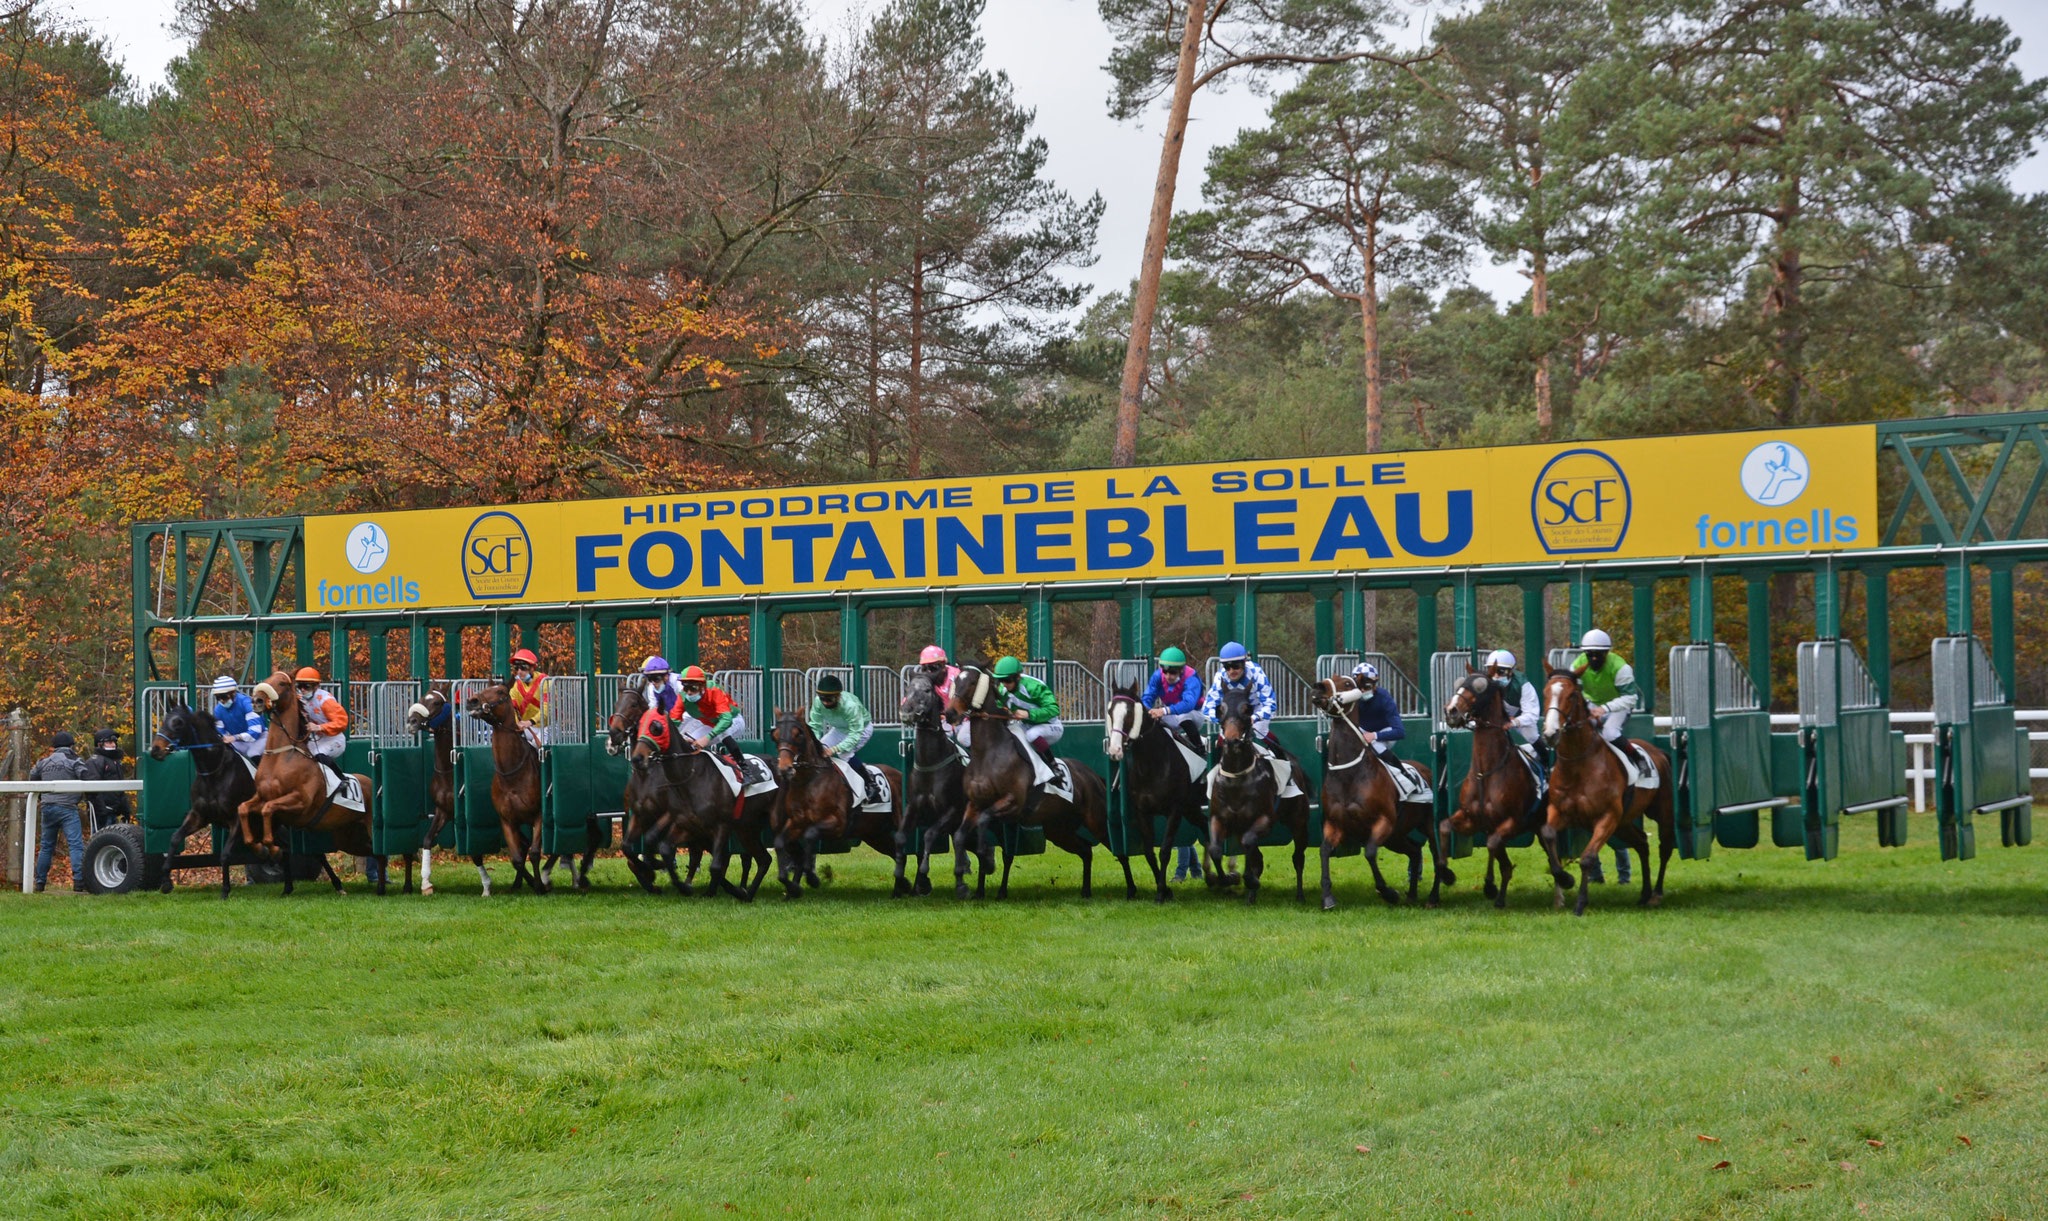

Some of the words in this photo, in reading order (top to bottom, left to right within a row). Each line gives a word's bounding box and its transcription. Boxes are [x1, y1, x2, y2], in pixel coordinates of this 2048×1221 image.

[624, 488, 973, 525] HIPPODROME
[1003, 481, 1075, 505] DE
[1107, 475, 1181, 499] LA
[1212, 462, 1406, 493] SOLLE
[575, 490, 1473, 593] FONTAINEBLEAU
[1695, 508, 1859, 549] fornells
[317, 575, 420, 606] fornells
